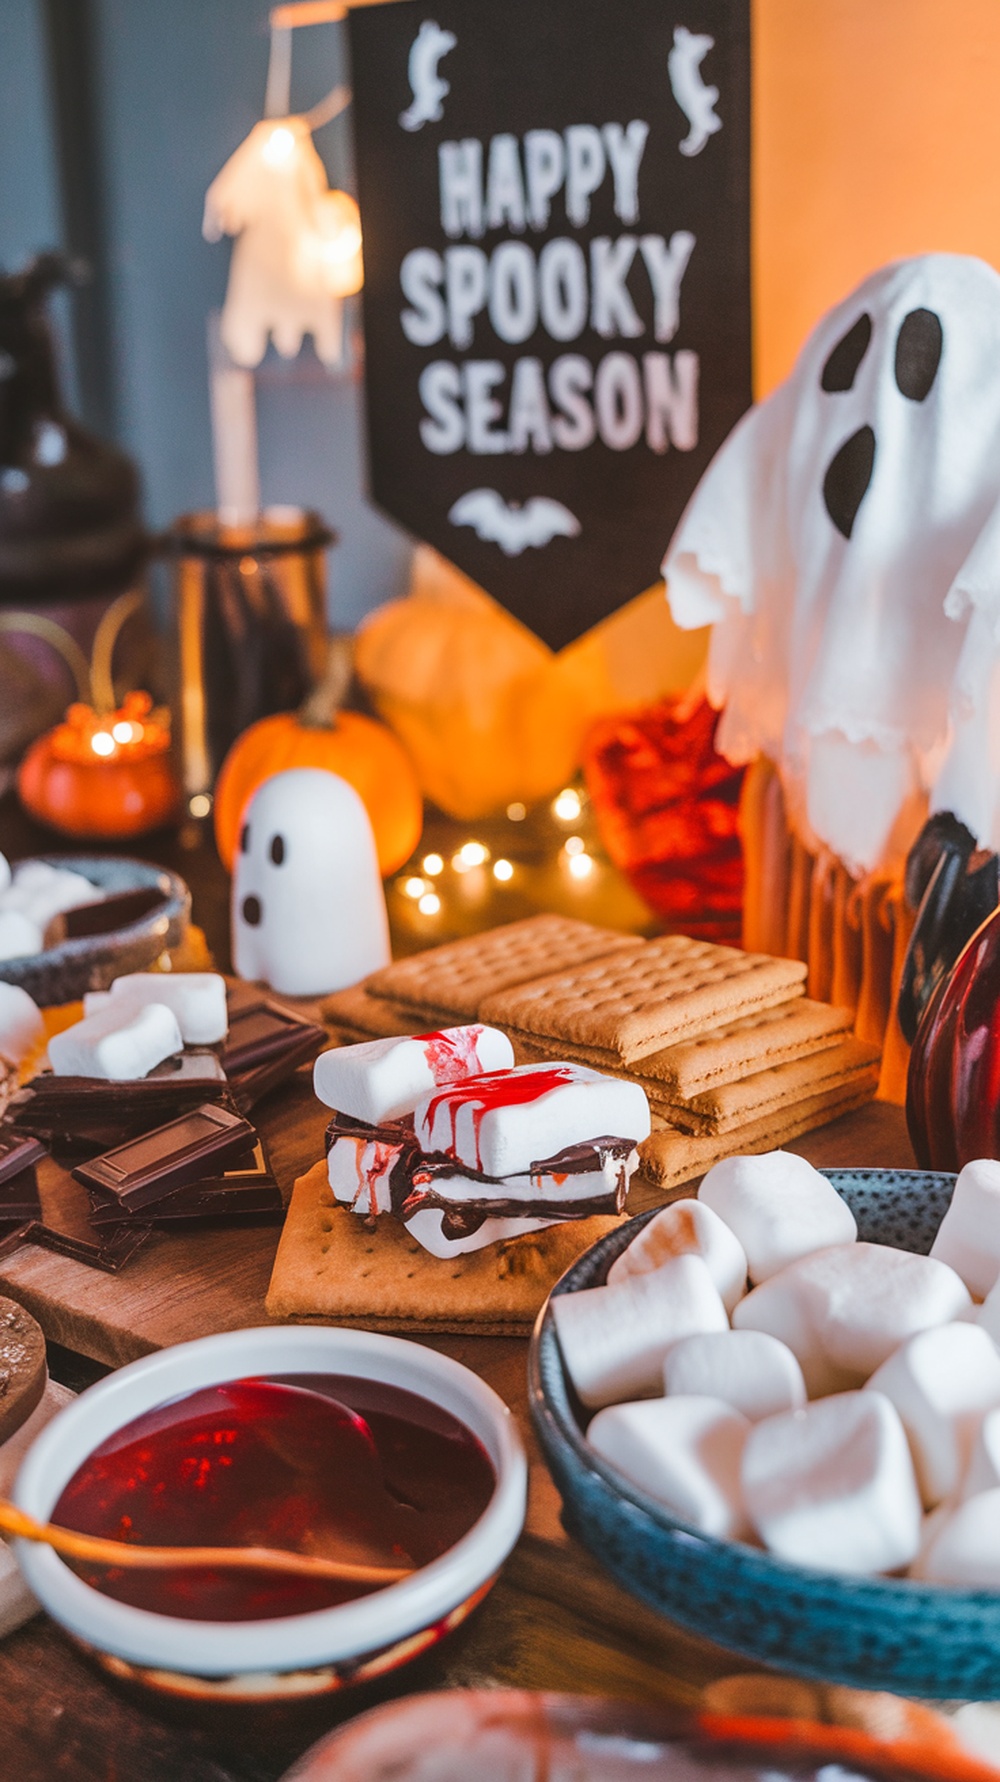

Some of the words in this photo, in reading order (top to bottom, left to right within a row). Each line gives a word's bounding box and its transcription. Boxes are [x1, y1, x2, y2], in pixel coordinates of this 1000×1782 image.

[438, 120, 649, 240] HAPPY
[400, 231, 696, 350] SPOOKY
[418, 350, 699, 455] SEASON
